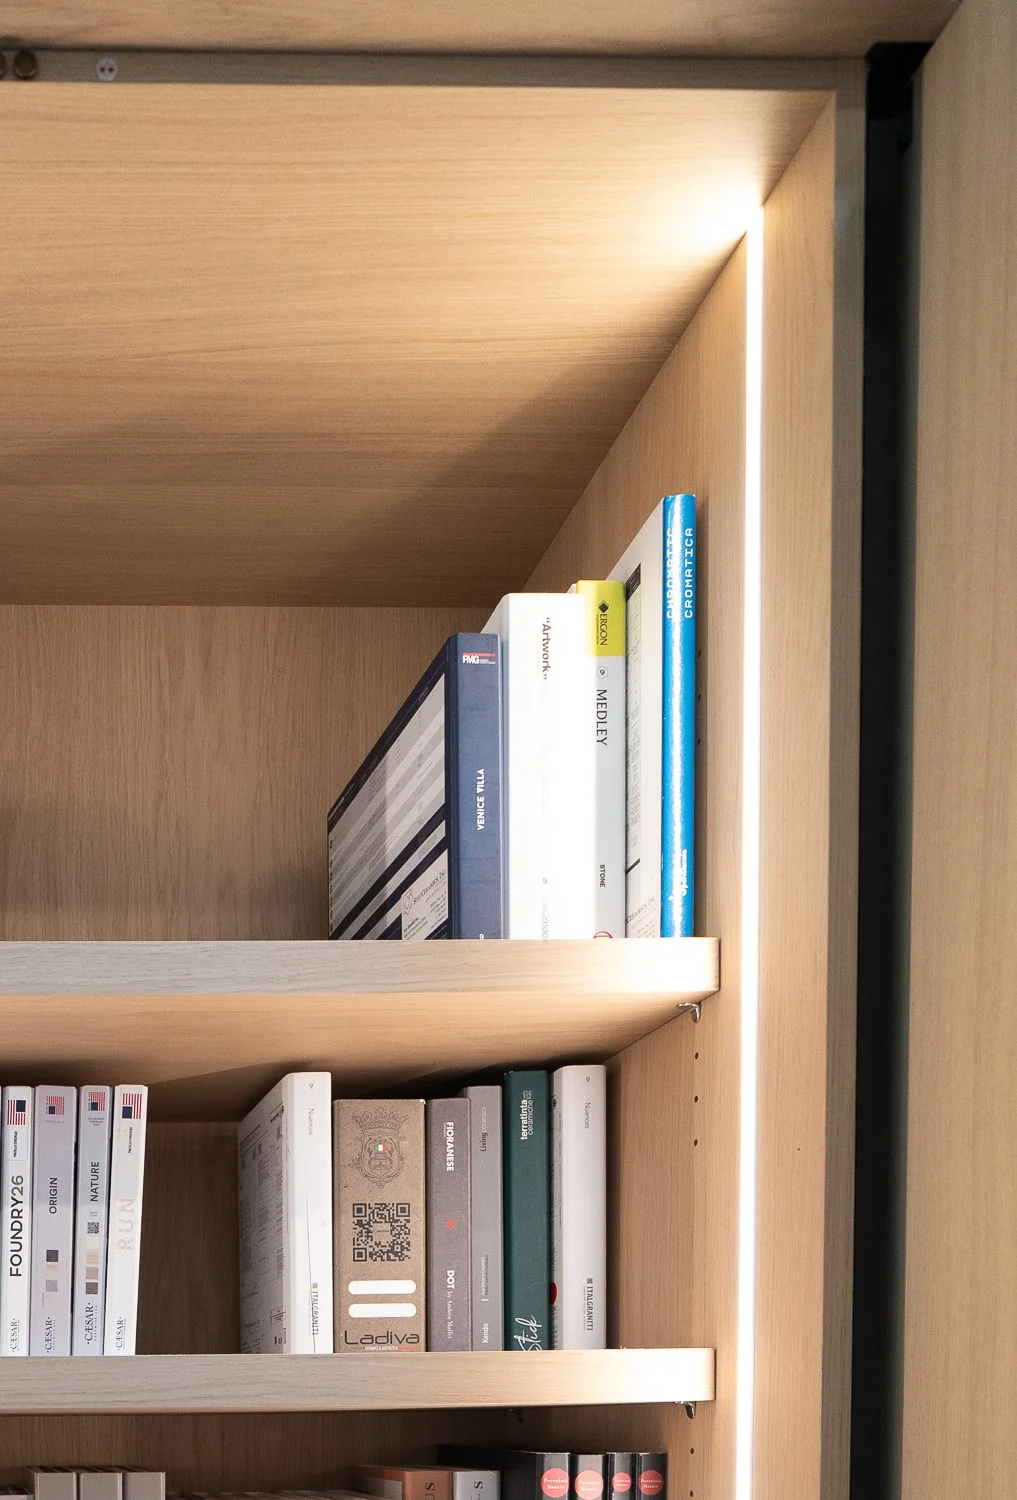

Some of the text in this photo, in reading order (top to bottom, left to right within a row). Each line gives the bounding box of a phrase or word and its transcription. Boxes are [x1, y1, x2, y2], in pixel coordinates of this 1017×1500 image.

[685, 528, 693, 618] CROMATICA
[597, 689, 607, 745] MEDLEY
[477, 769, 485, 831] VENICE VILLA
[446, 1122, 454, 1171] FIORANESE
[49, 1177, 57, 1214] ORIGIN
[90, 1162, 99, 1202] NATURE
[10, 1175, 24, 1277] FOUNDRY26
[447, 1270, 455, 1289] DOT
[345, 1330, 419, 1345] Ladiva
[514, 1315, 542, 1351] Stick
